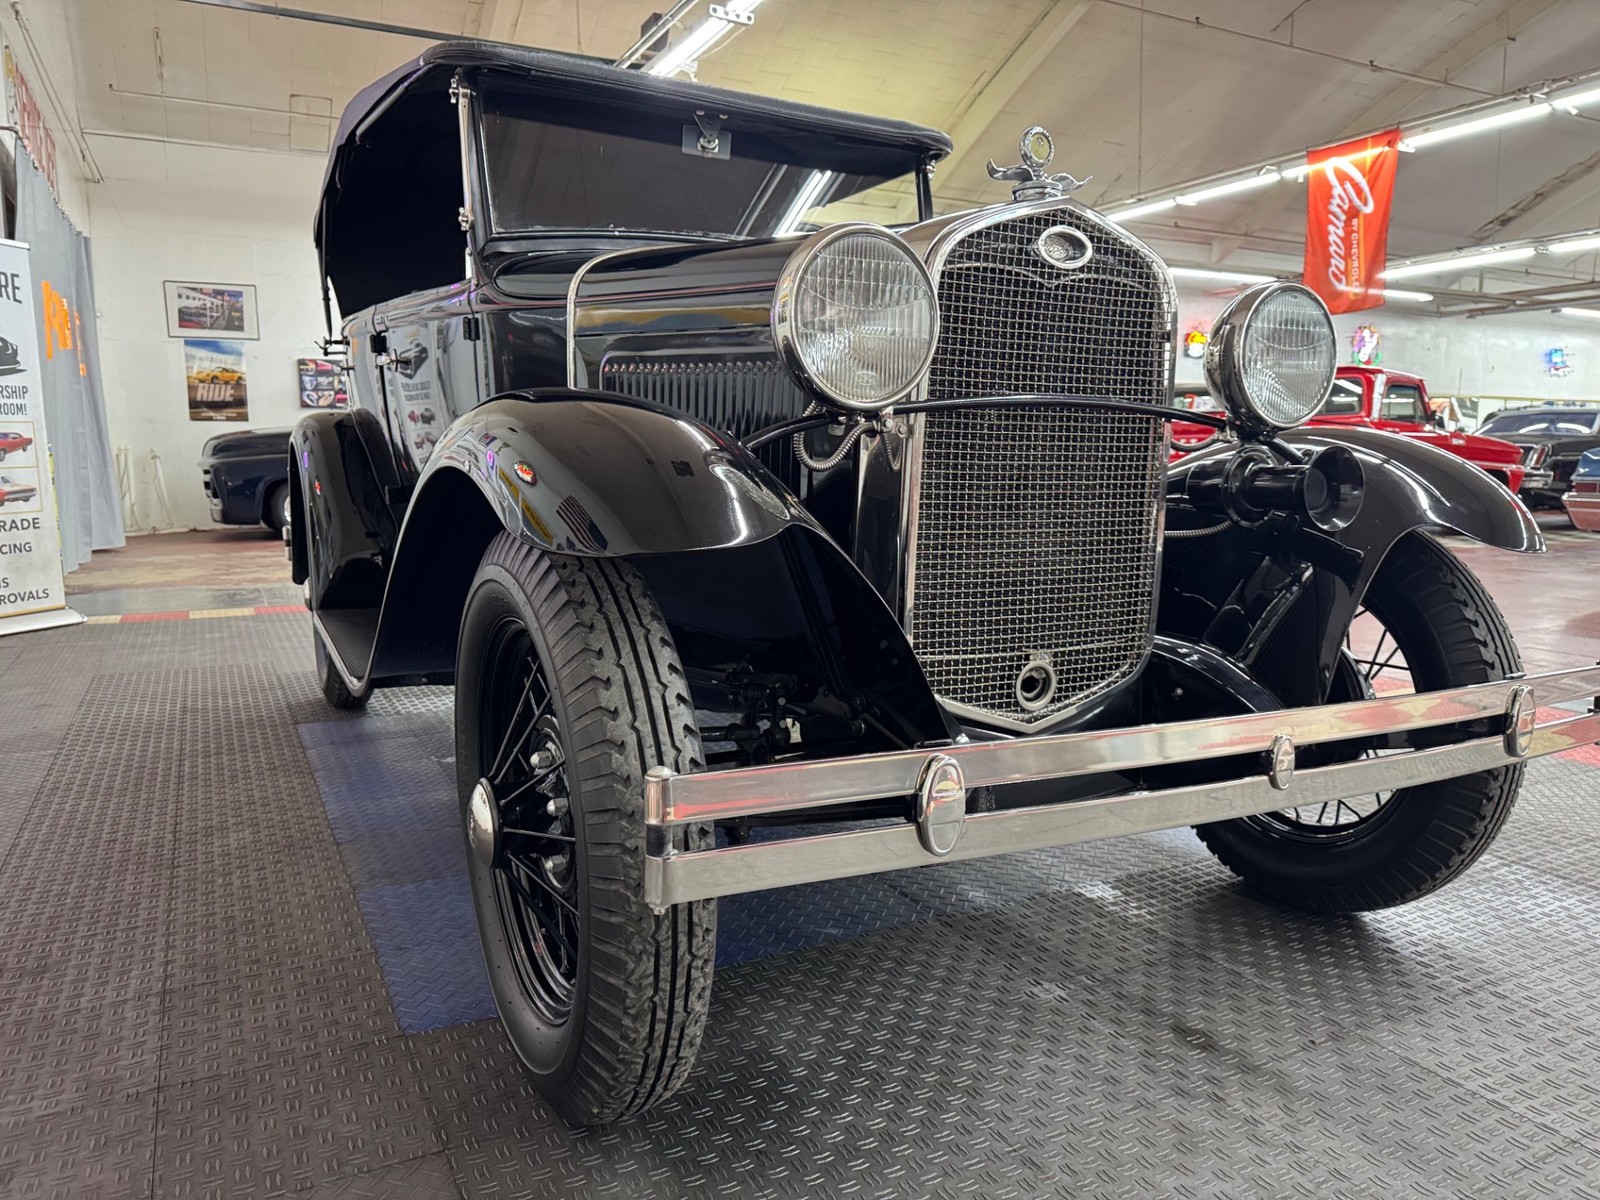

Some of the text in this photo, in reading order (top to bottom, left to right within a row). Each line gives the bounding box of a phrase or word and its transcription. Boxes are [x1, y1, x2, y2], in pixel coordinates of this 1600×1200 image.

[1325, 157, 1374, 291] Camaro
[1351, 218, 1361, 293] BY CHEVROLE
[0, 271, 22, 304] RE
[0, 385, 28, 399] RSHIP
[196, 383, 234, 401] RIDE
[0, 517, 40, 532] RADE
[0, 542, 32, 555] CING
[0, 588, 49, 605] ROVALS
